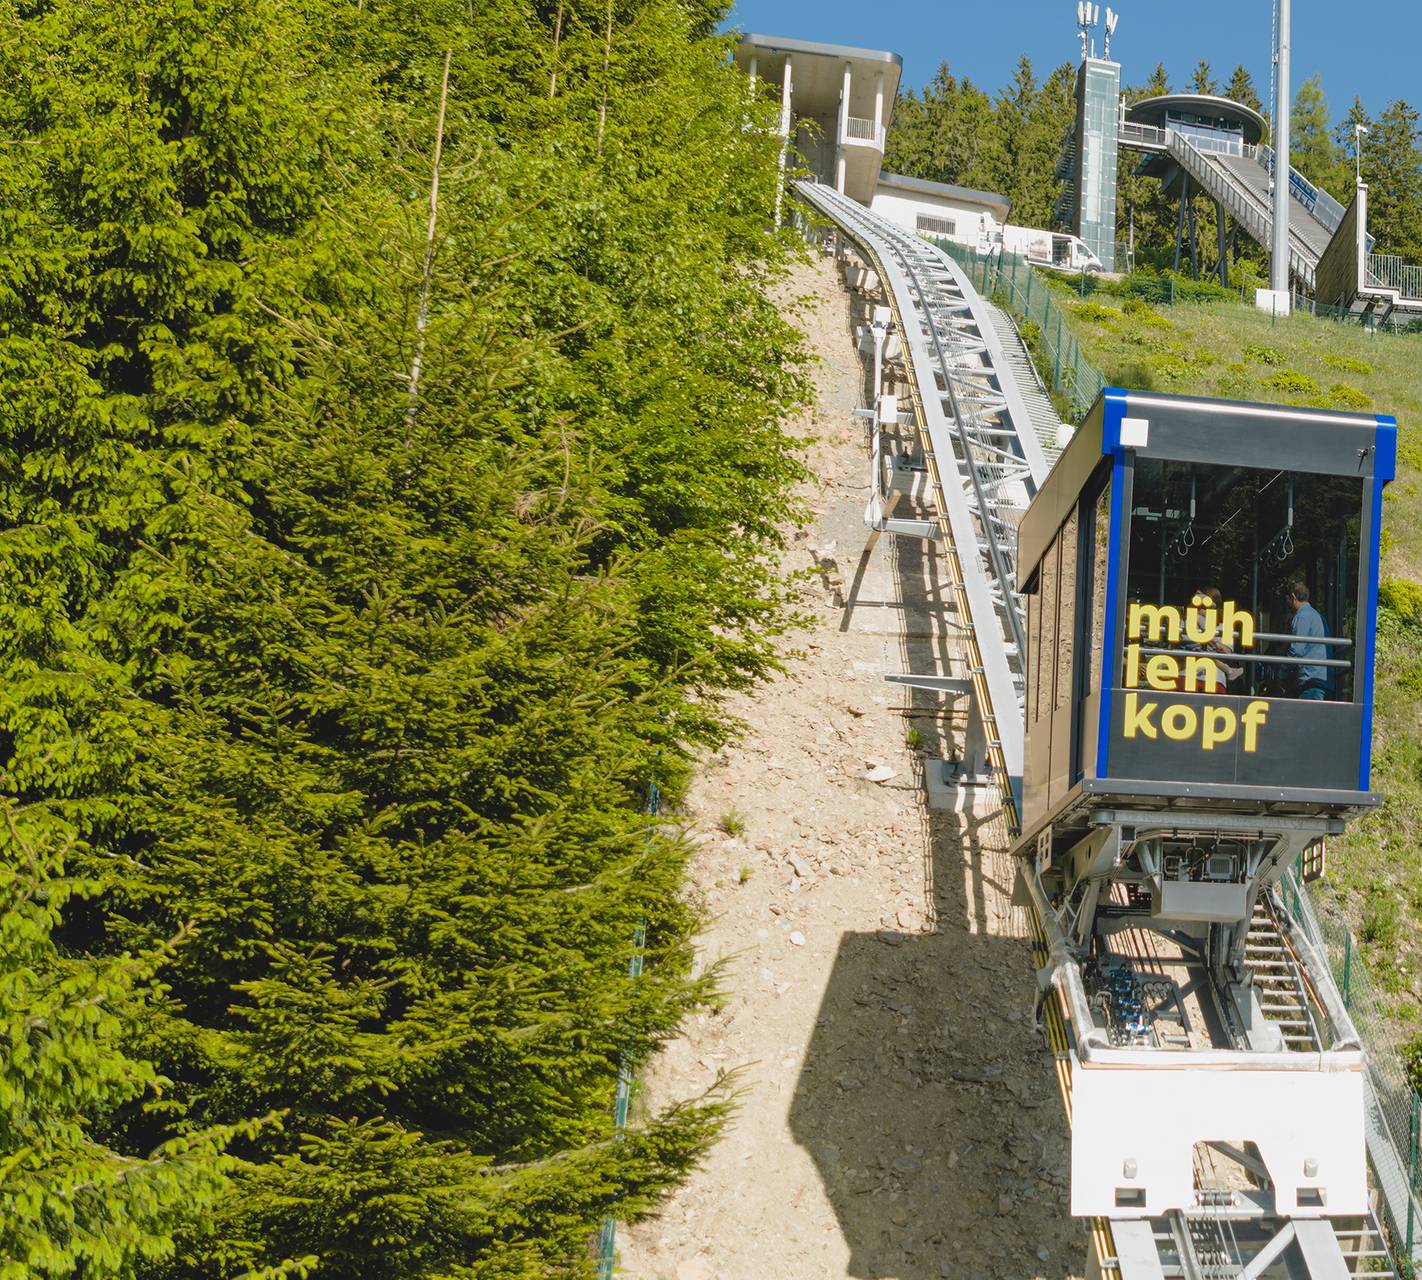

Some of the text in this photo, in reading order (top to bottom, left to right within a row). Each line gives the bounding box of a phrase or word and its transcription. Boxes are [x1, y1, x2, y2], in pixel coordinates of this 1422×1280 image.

[1128, 595, 1255, 647] müh
[1125, 643, 1218, 694] len
[1123, 692, 1270, 753] kopf
